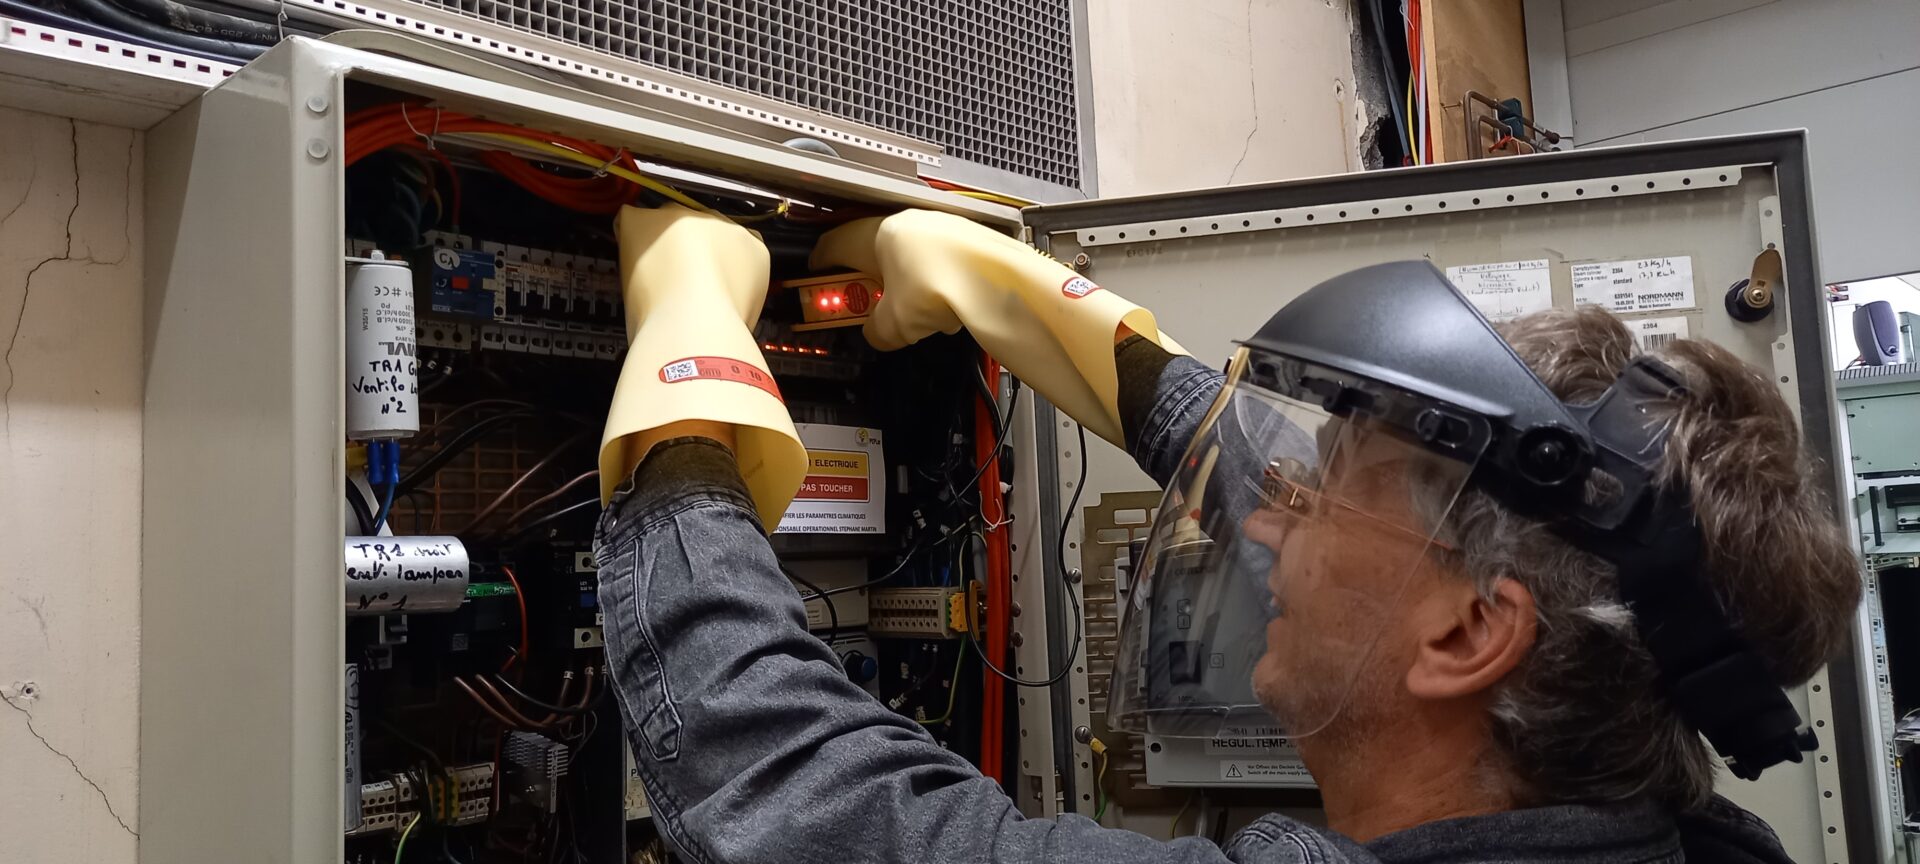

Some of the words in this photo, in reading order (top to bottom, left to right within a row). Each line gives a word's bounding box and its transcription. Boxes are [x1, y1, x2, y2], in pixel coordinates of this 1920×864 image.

[1638, 291, 1684, 300] NORDMANN
[815, 459, 859, 469] ELECTRIQUE
[800, 483, 817, 492] PAS
[819, 484, 853, 493] TOUCHER
[796, 512, 805, 520] LES
[805, 512, 837, 520] PARAMETRES
